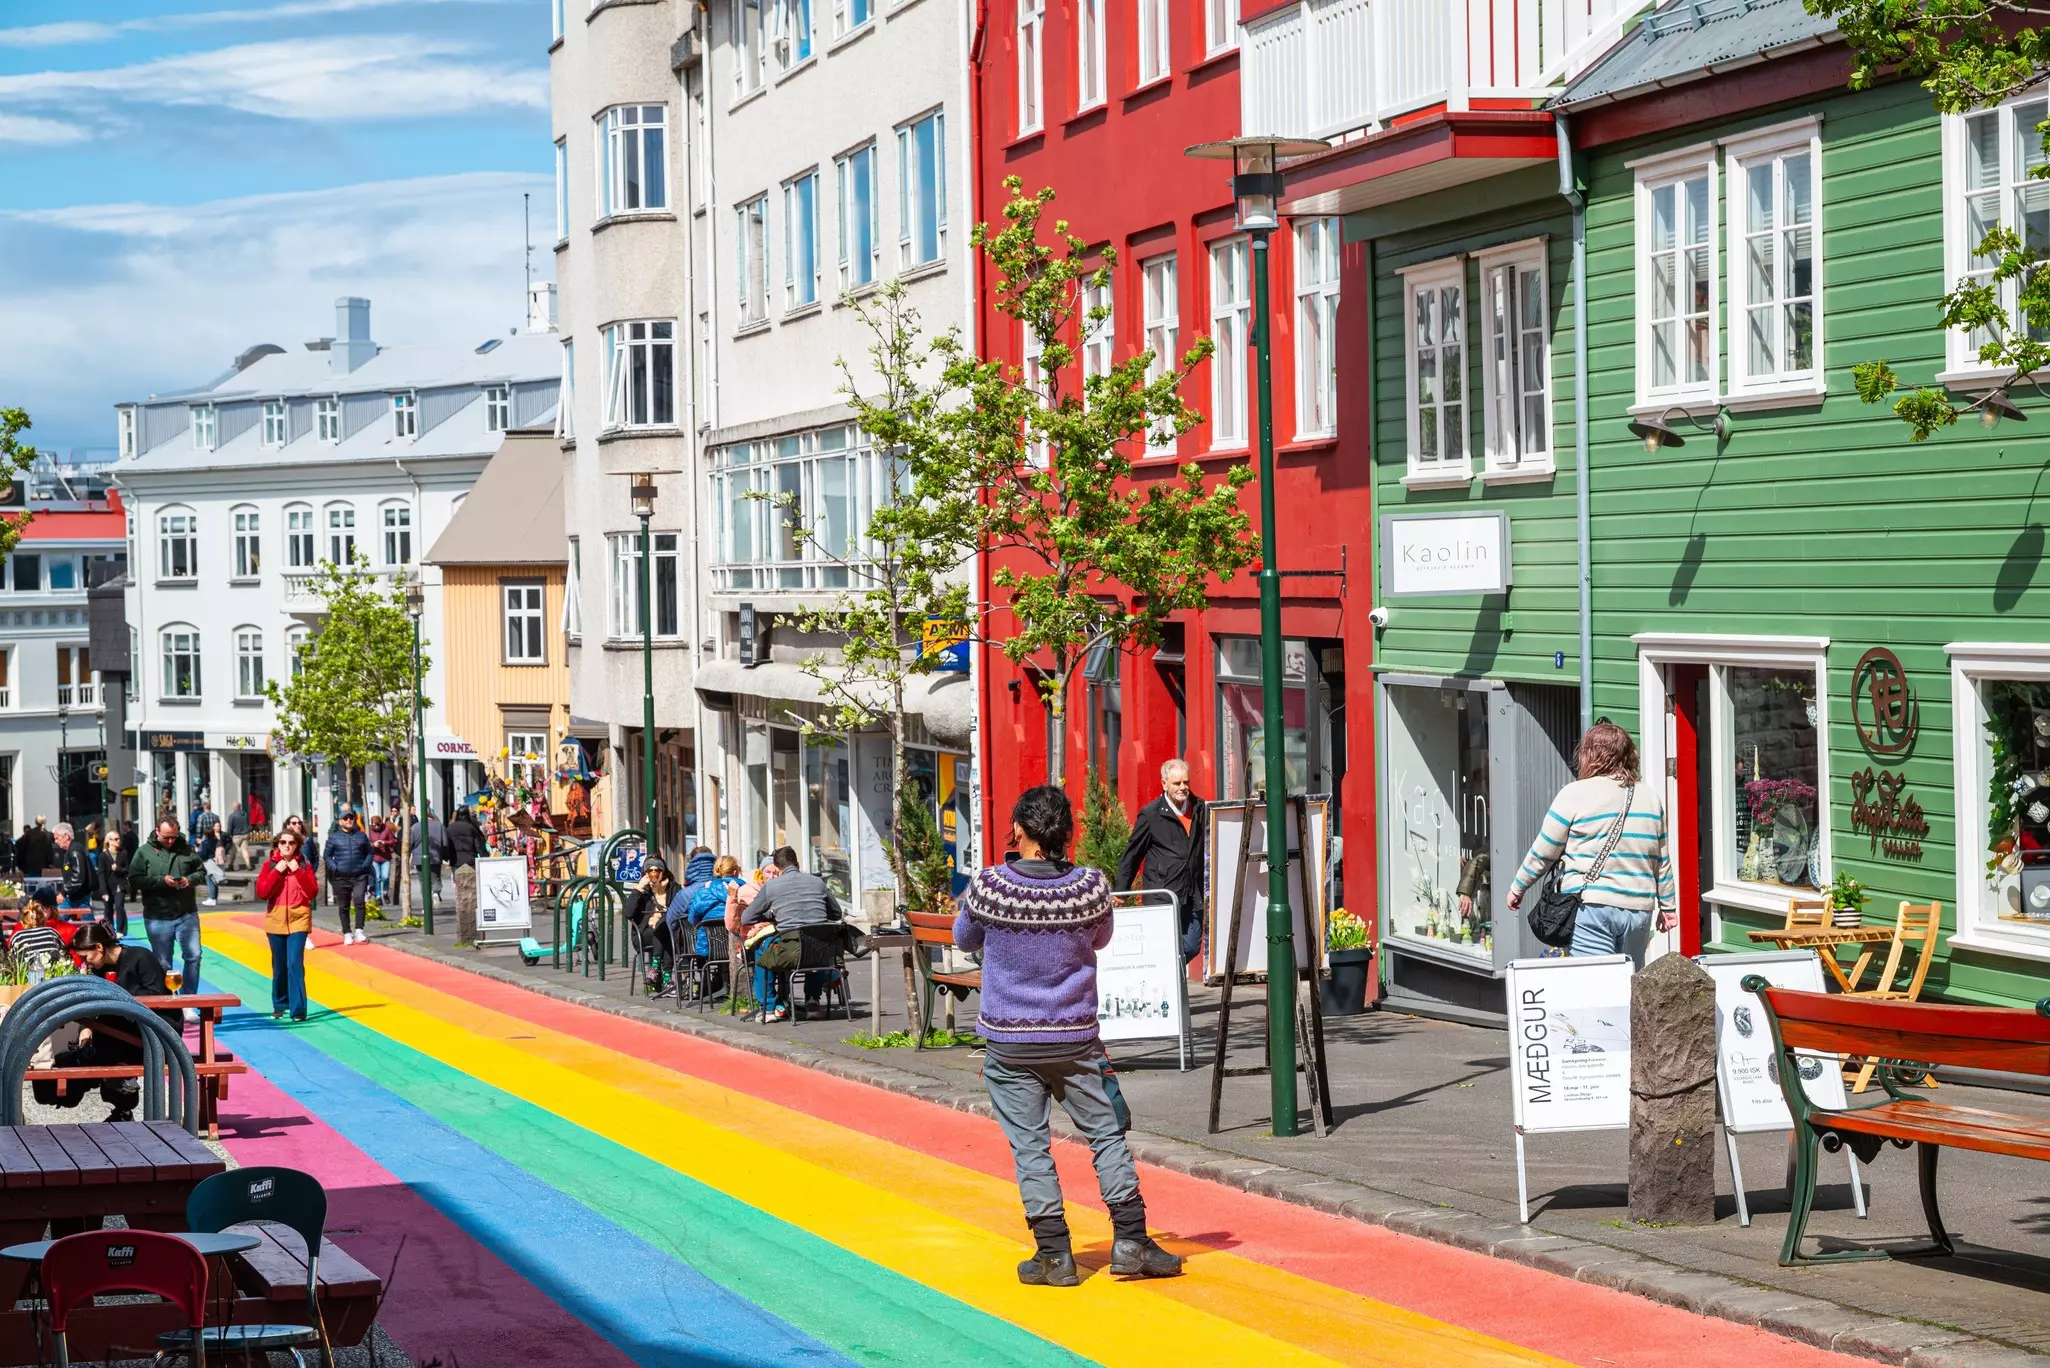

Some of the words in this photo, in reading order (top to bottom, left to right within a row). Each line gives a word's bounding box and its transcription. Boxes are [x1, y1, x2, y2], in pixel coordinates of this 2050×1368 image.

[1403, 540, 1487, 563] Kaolin
[928, 623, 965, 637] ATM
[437, 742, 478, 754] CORNE
[1395, 767, 1487, 838] Kaolin
[1522, 987, 1552, 1104] MÆÐGUR
[250, 1179, 273, 1194] Kaffi
[107, 1246, 134, 1257] Kaffi
